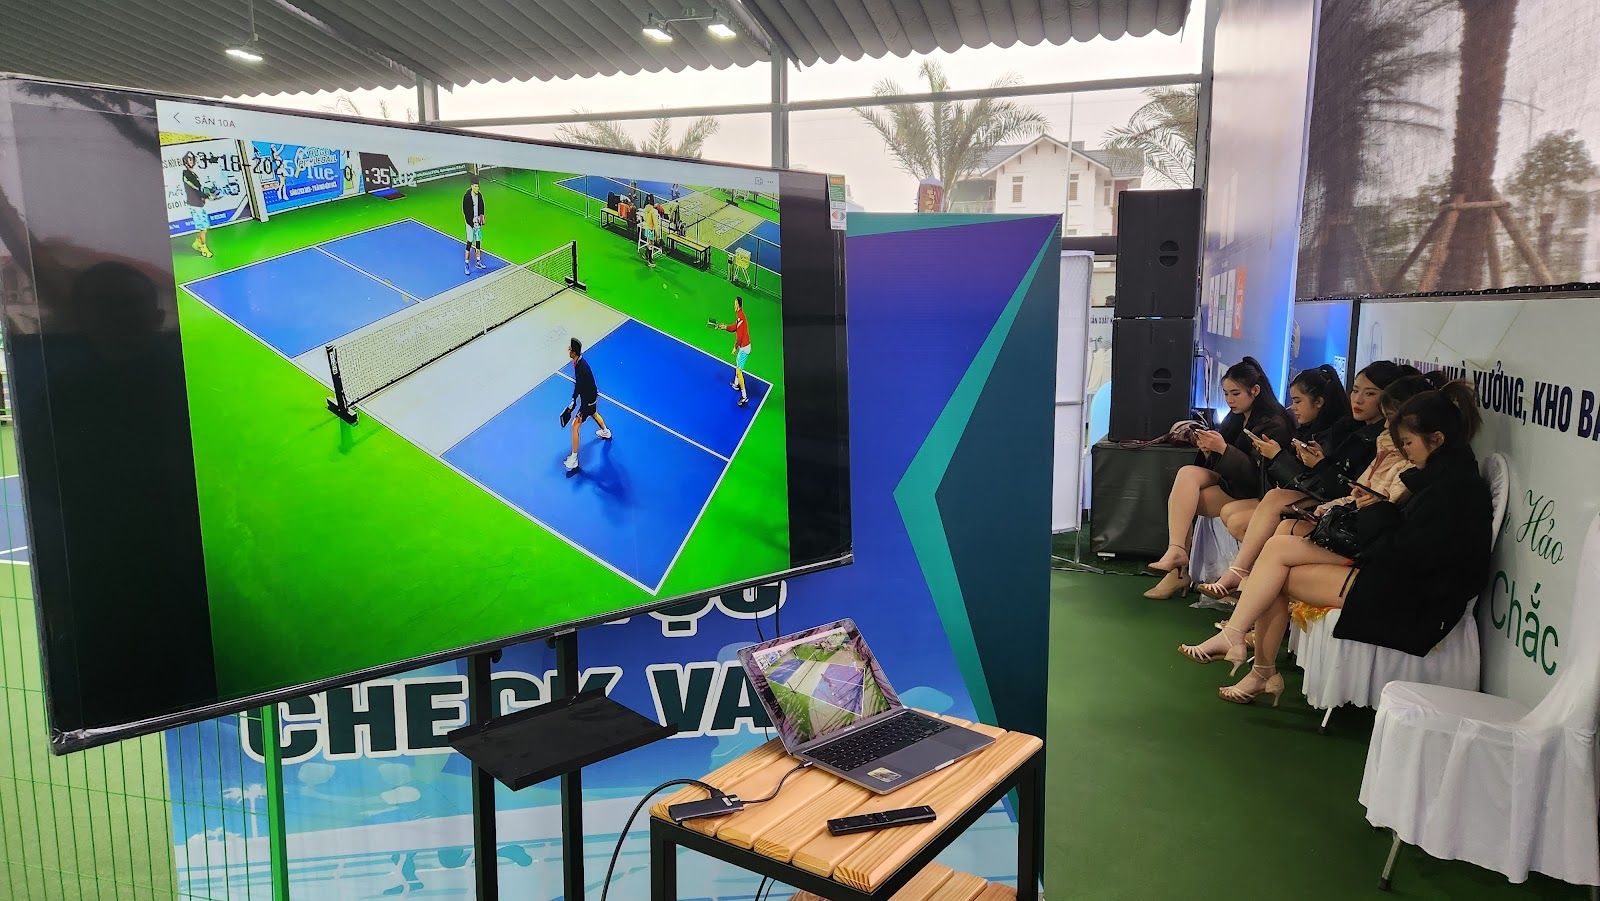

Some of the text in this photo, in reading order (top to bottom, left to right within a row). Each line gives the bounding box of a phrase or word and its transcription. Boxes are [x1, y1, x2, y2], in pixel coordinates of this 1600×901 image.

[218, 119, 236, 128] 10A
[1532, 381, 1573, 433] KHO
[1516, 489, 1565, 565] Hảo
[1491, 570, 1559, 676] Chắc
